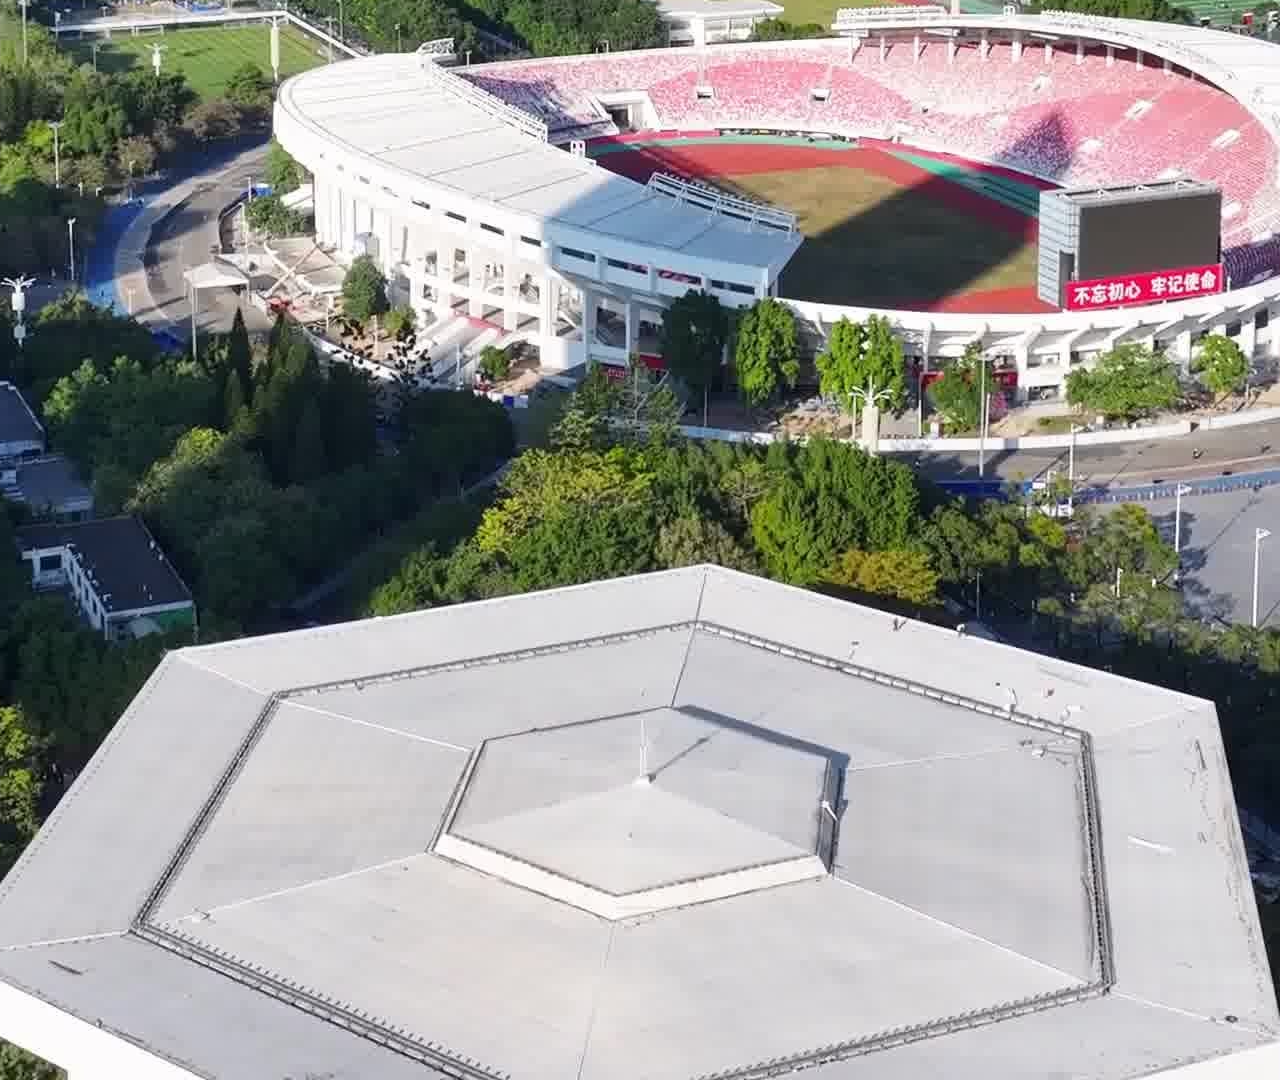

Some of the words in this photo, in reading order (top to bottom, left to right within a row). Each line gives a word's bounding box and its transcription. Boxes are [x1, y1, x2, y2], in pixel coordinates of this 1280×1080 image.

[1073, 280, 1142, 306] 不忘初心
[1151, 269, 1217, 297] 牢记使命
